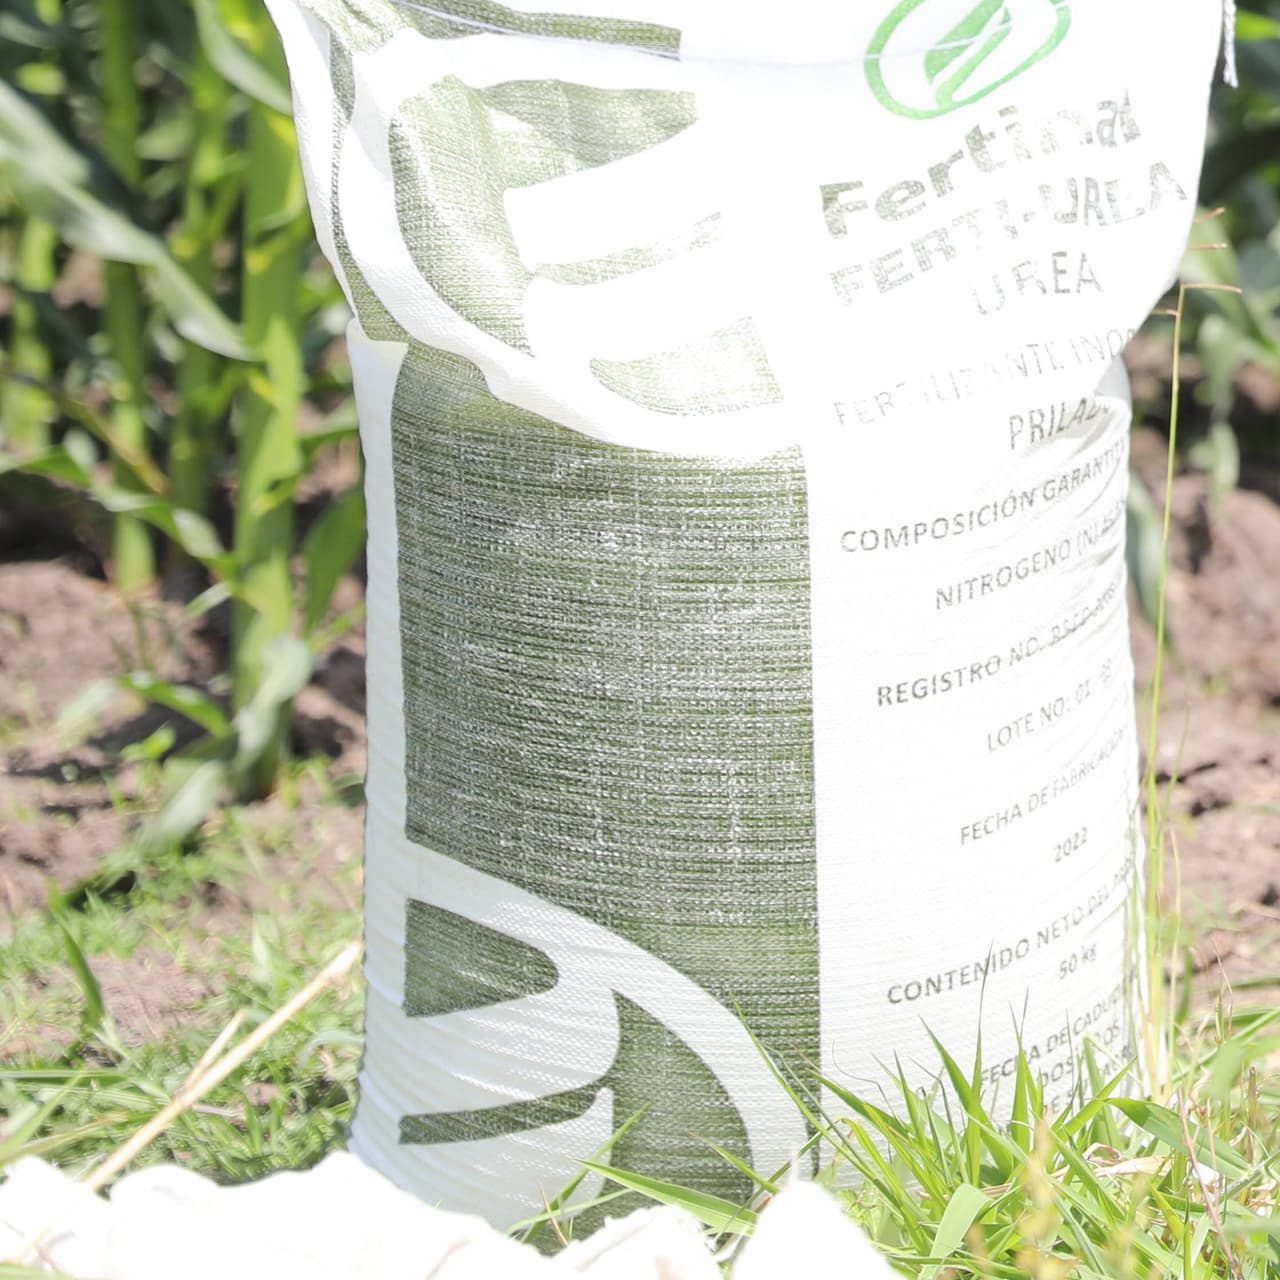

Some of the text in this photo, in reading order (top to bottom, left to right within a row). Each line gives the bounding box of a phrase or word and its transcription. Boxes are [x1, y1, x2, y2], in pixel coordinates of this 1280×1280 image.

[970, 251, 1104, 316] UREA
[840, 488, 1036, 553] COMPOSICIÓN
[876, 654, 1002, 708] REGISTRO
[986, 714, 1037, 754] LOTE
[960, 802, 1024, 847] FECHA
[1027, 785, 1050, 814] DE
[1053, 826, 1090, 865] 2022
[886, 937, 1031, 1005] CONTENIDO
[1035, 905, 1084, 948] NETO
[1058, 952, 1078, 981] 50
[1045, 1024, 1071, 1055] DE
